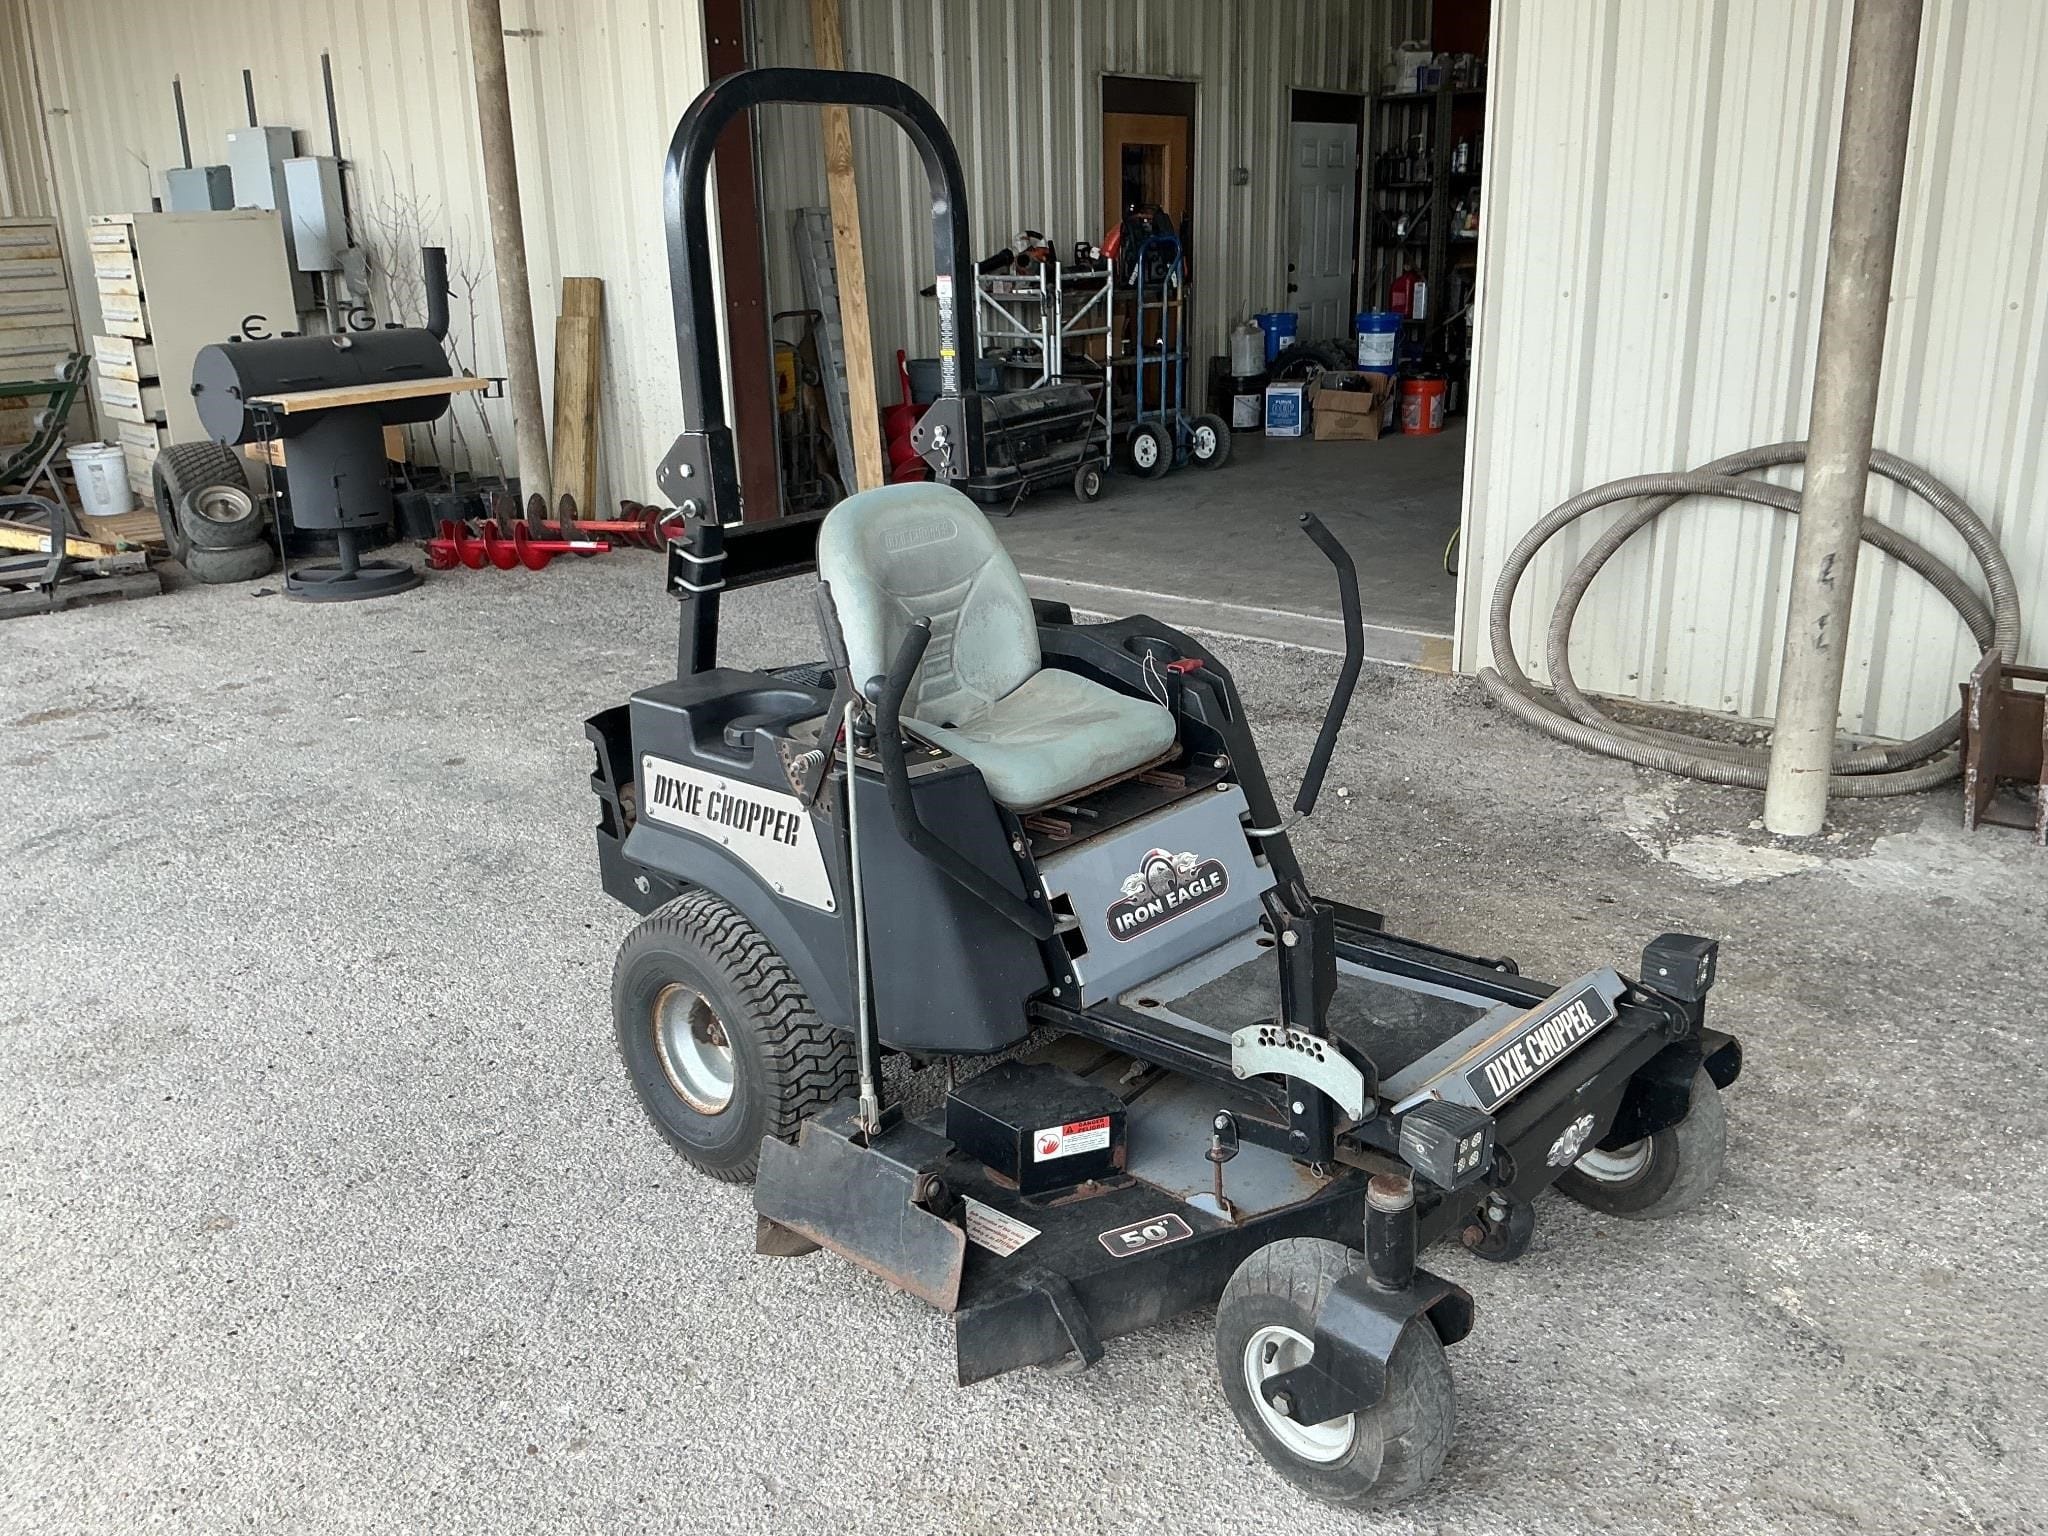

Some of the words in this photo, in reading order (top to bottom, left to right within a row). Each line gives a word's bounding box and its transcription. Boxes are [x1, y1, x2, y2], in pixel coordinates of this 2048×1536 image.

[653, 774, 704, 817] DIXIE
[706, 790, 801, 847] CHOPPER
[1115, 898, 1164, 933] IRON
[1165, 871, 1222, 909] EAGLE
[1484, 1042, 1534, 1098] DIXIE
[1525, 999, 1596, 1066] CHOPPER
[1078, 1118, 1105, 1127] DANGER
[1078, 1123, 1106, 1132] PELIGRO
[1119, 1219, 1169, 1249] 50"
